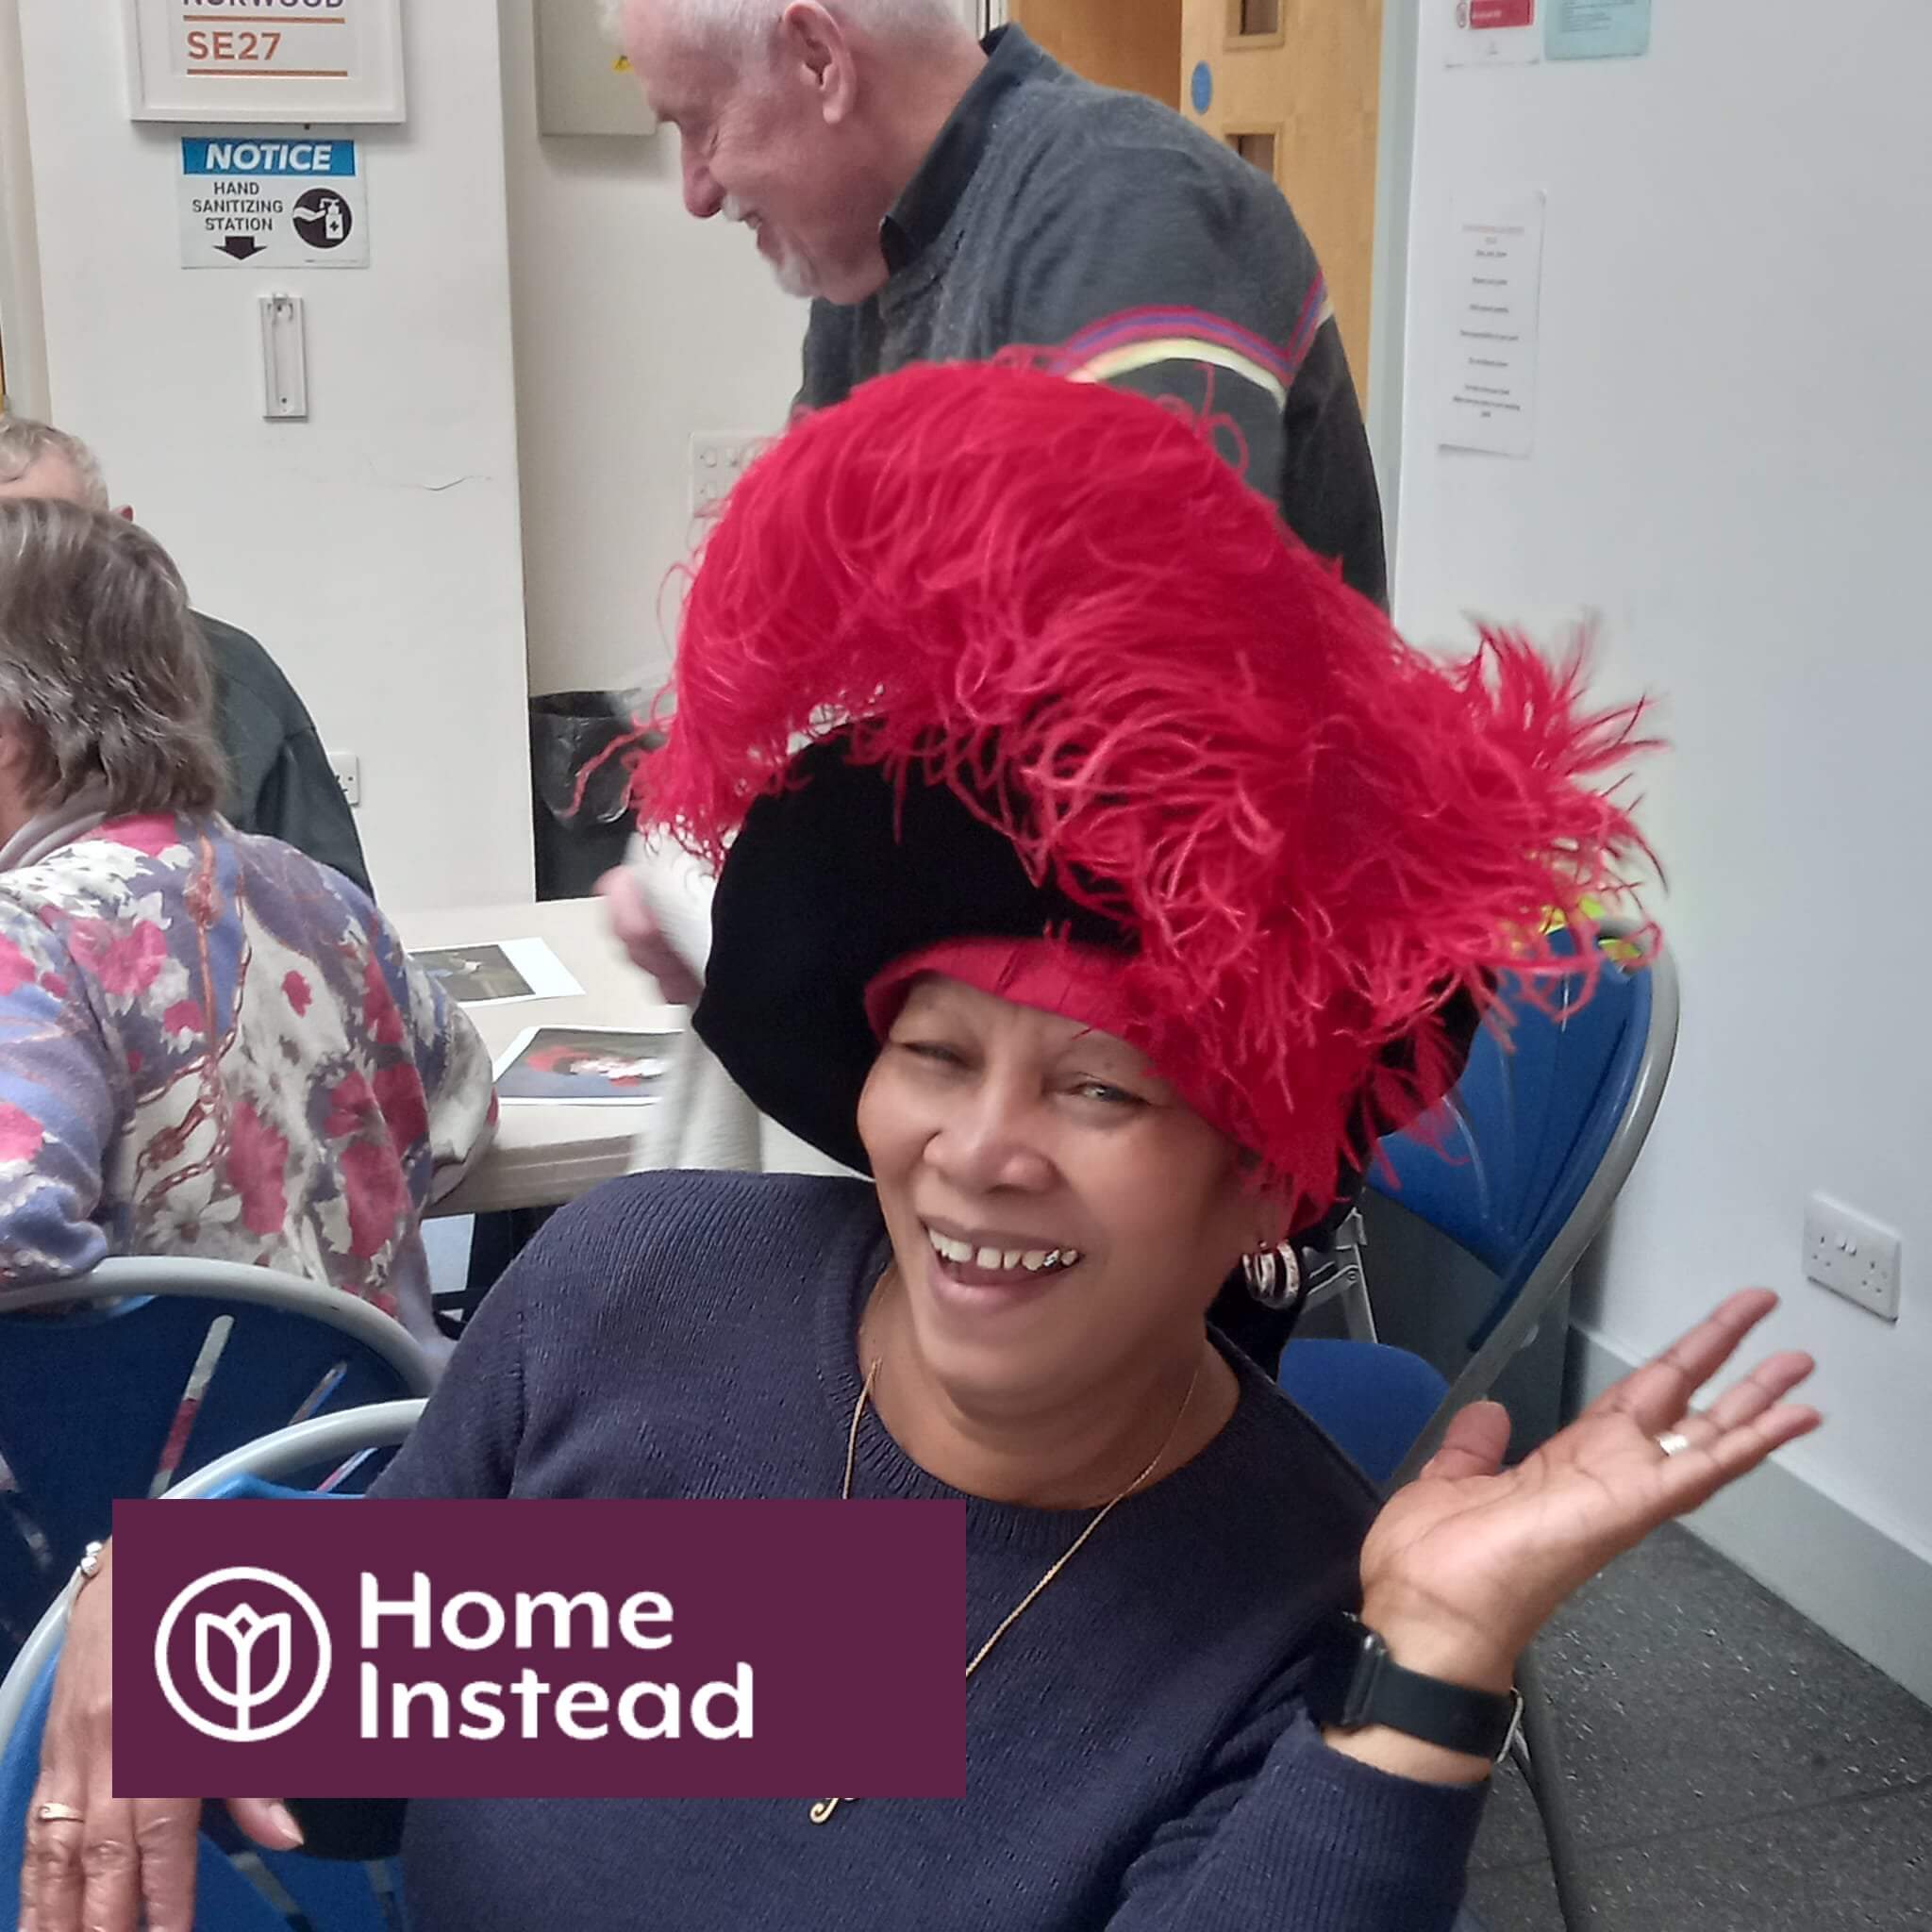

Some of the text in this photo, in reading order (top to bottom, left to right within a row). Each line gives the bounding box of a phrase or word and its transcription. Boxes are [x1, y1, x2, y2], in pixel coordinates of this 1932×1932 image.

[187, 31, 281, 60] SE27
[206, 143, 332, 171] NOTICE
[214, 182, 259, 195] HAND
[192, 200, 283, 213] SANITIZING
[205, 218, 273, 231] STATION
